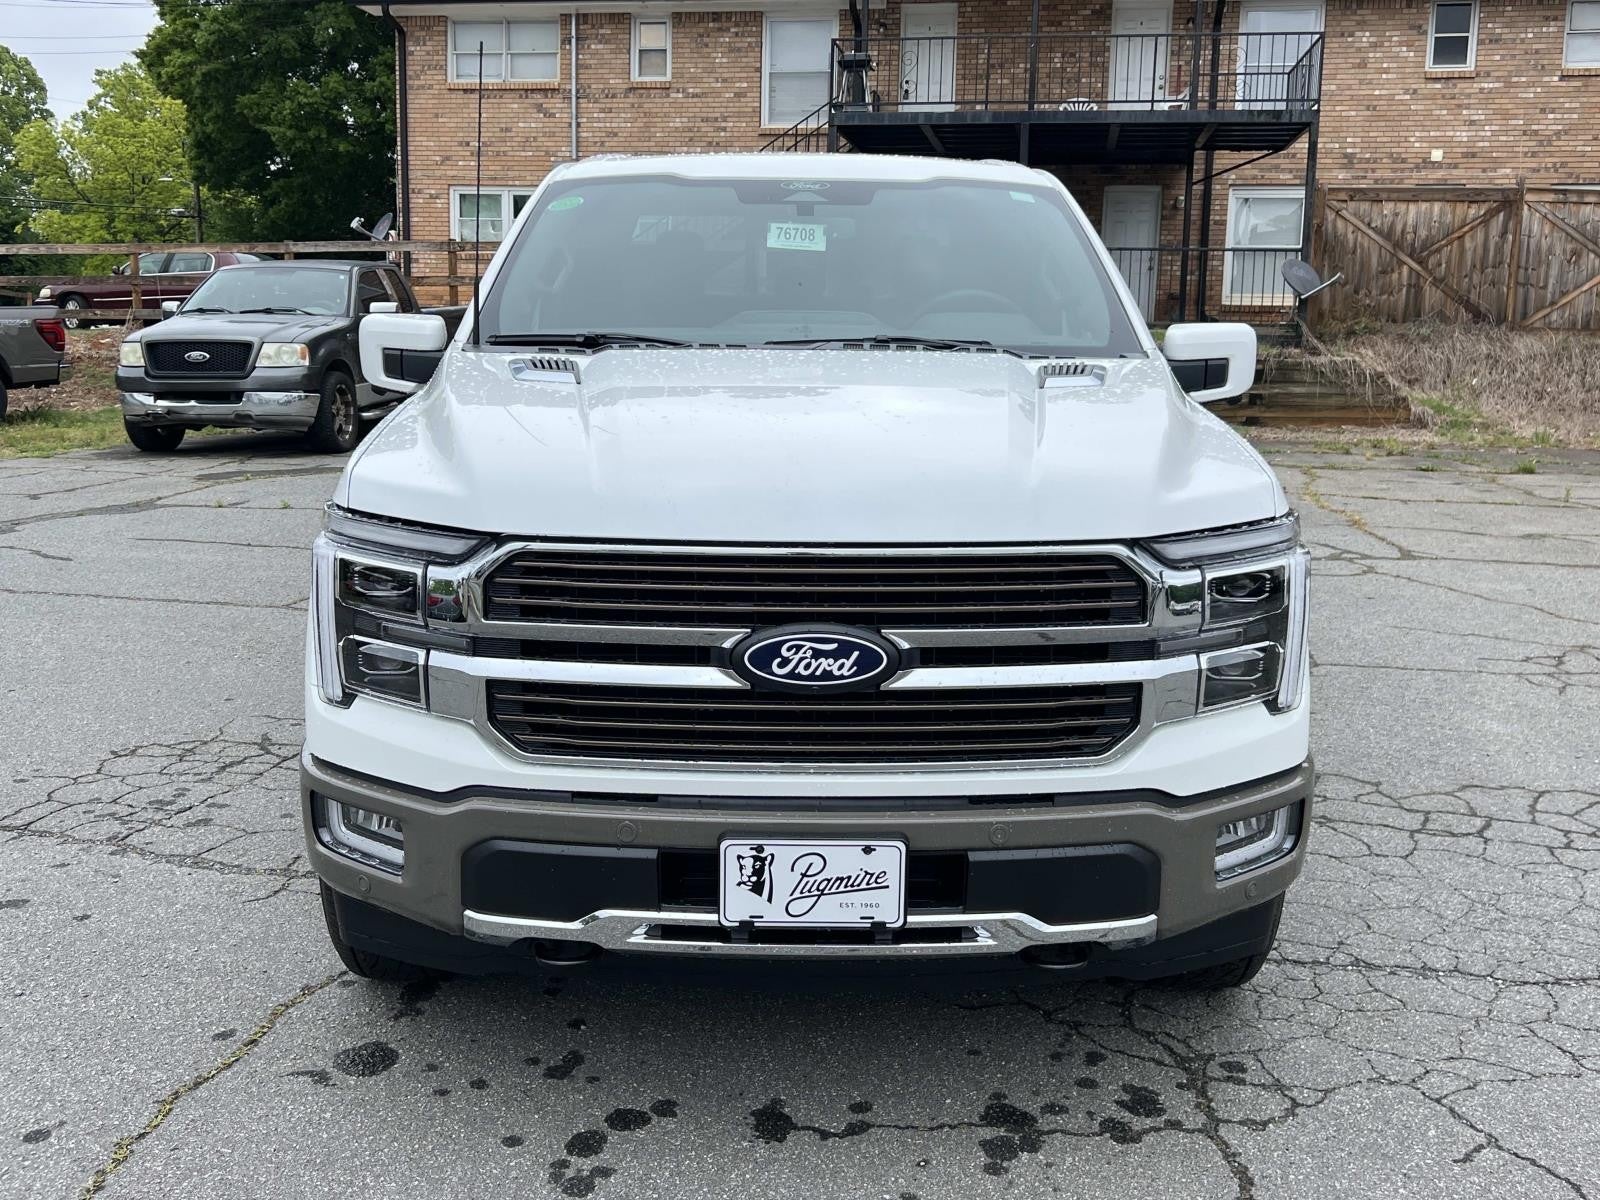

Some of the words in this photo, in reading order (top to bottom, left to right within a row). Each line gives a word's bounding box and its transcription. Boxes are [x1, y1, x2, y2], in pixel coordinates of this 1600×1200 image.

[776, 227, 815, 242] 76708
[771, 640, 860, 676] Ford
[785, 852, 890, 918] Pugmire
